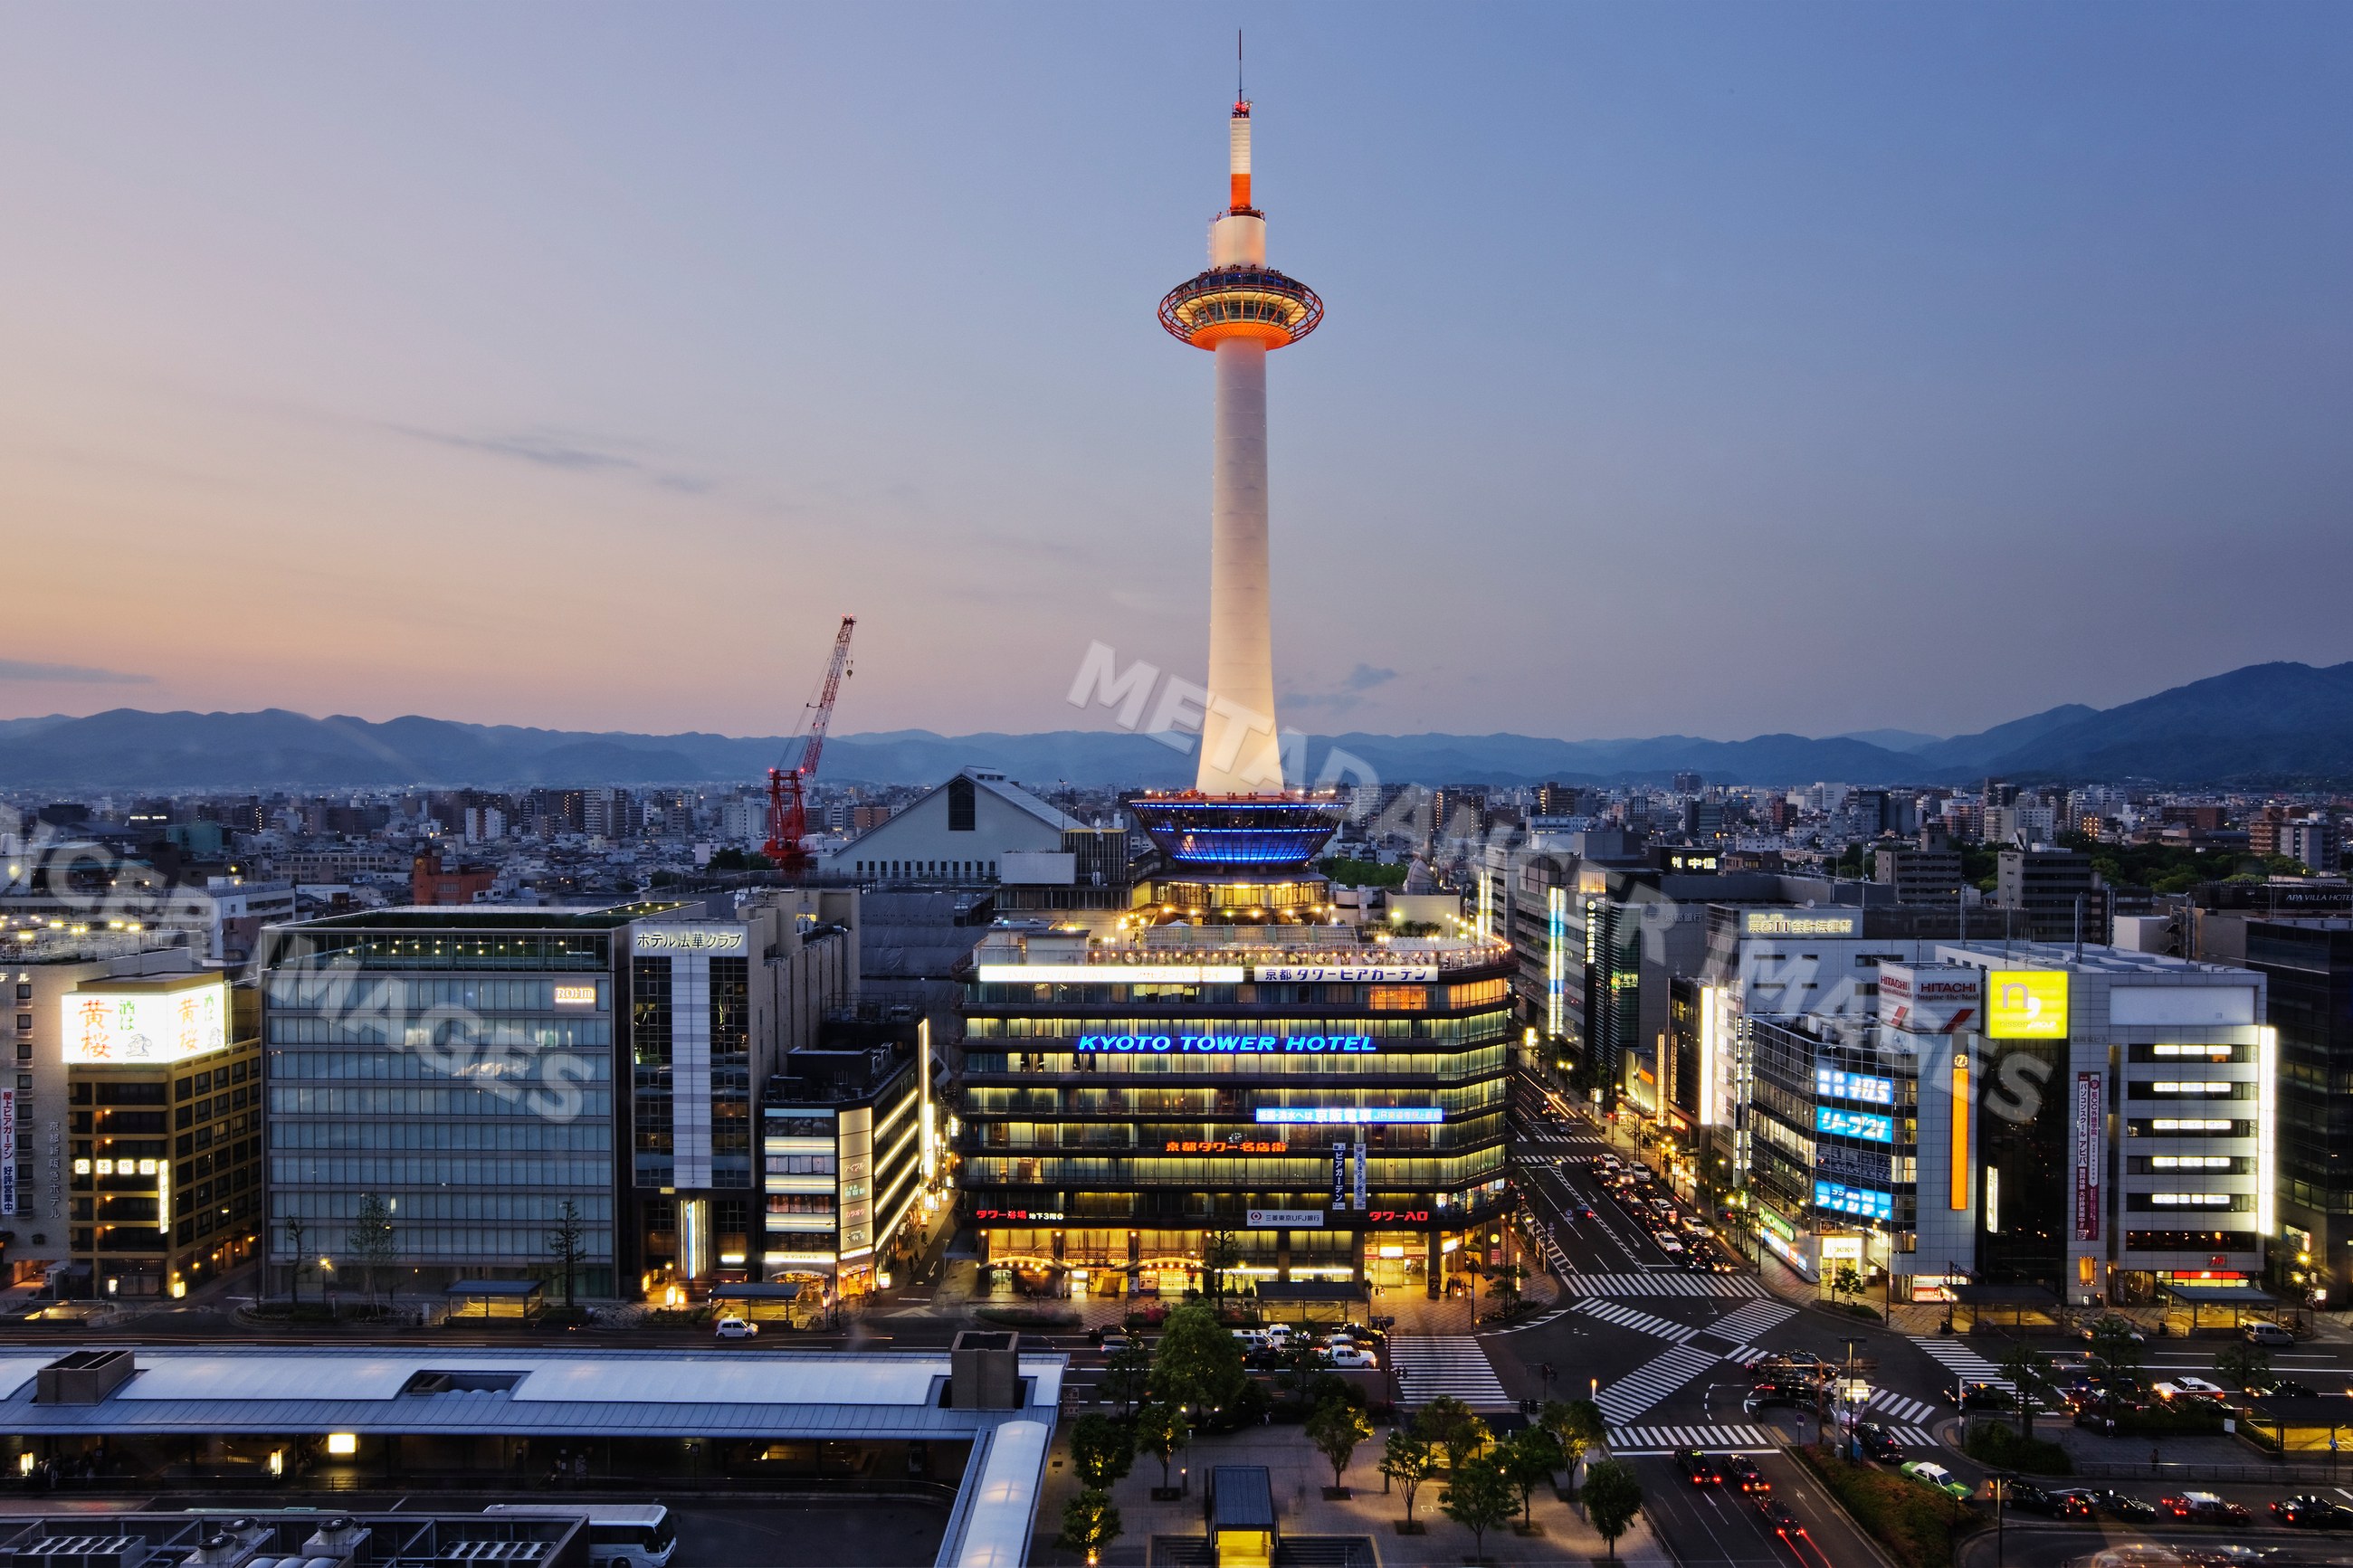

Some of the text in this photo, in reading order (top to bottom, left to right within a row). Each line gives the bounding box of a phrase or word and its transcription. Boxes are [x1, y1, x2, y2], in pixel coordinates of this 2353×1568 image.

[1688, 858, 1717, 870] 中信
[1664, 912, 1702, 923] 京都銀行
[636, 932, 743, 950] ホテル法華クラブ
[1880, 975, 1909, 991] HITACHI
[1920, 983, 1977, 993] HITACHI
[118, 998, 136, 1031] 酒は
[79, 998, 114, 1060] 黄桜
[177, 998, 200, 1052] 黄桜
[1079, 1035, 1377, 1051] KYOTO TOWER HOTEL
[1315, 1107, 1372, 1122] 京阪電車
[3, 1091, 14, 1212] 屋上ビアガーデン 好評営業中
[1166, 1142, 1286, 1153] 京都タワー名店街
[2078, 1140, 2087, 1164] アビバ
[49, 1121, 60, 1218] 京都新阪急ホテル
[1335, 1152, 1343, 1202] ビアガーデン
[976, 1210, 1026, 1220] タワー浴場
[1368, 1211, 1429, 1221] タワー入口
[1758, 1206, 1796, 1242] PACHINKO
